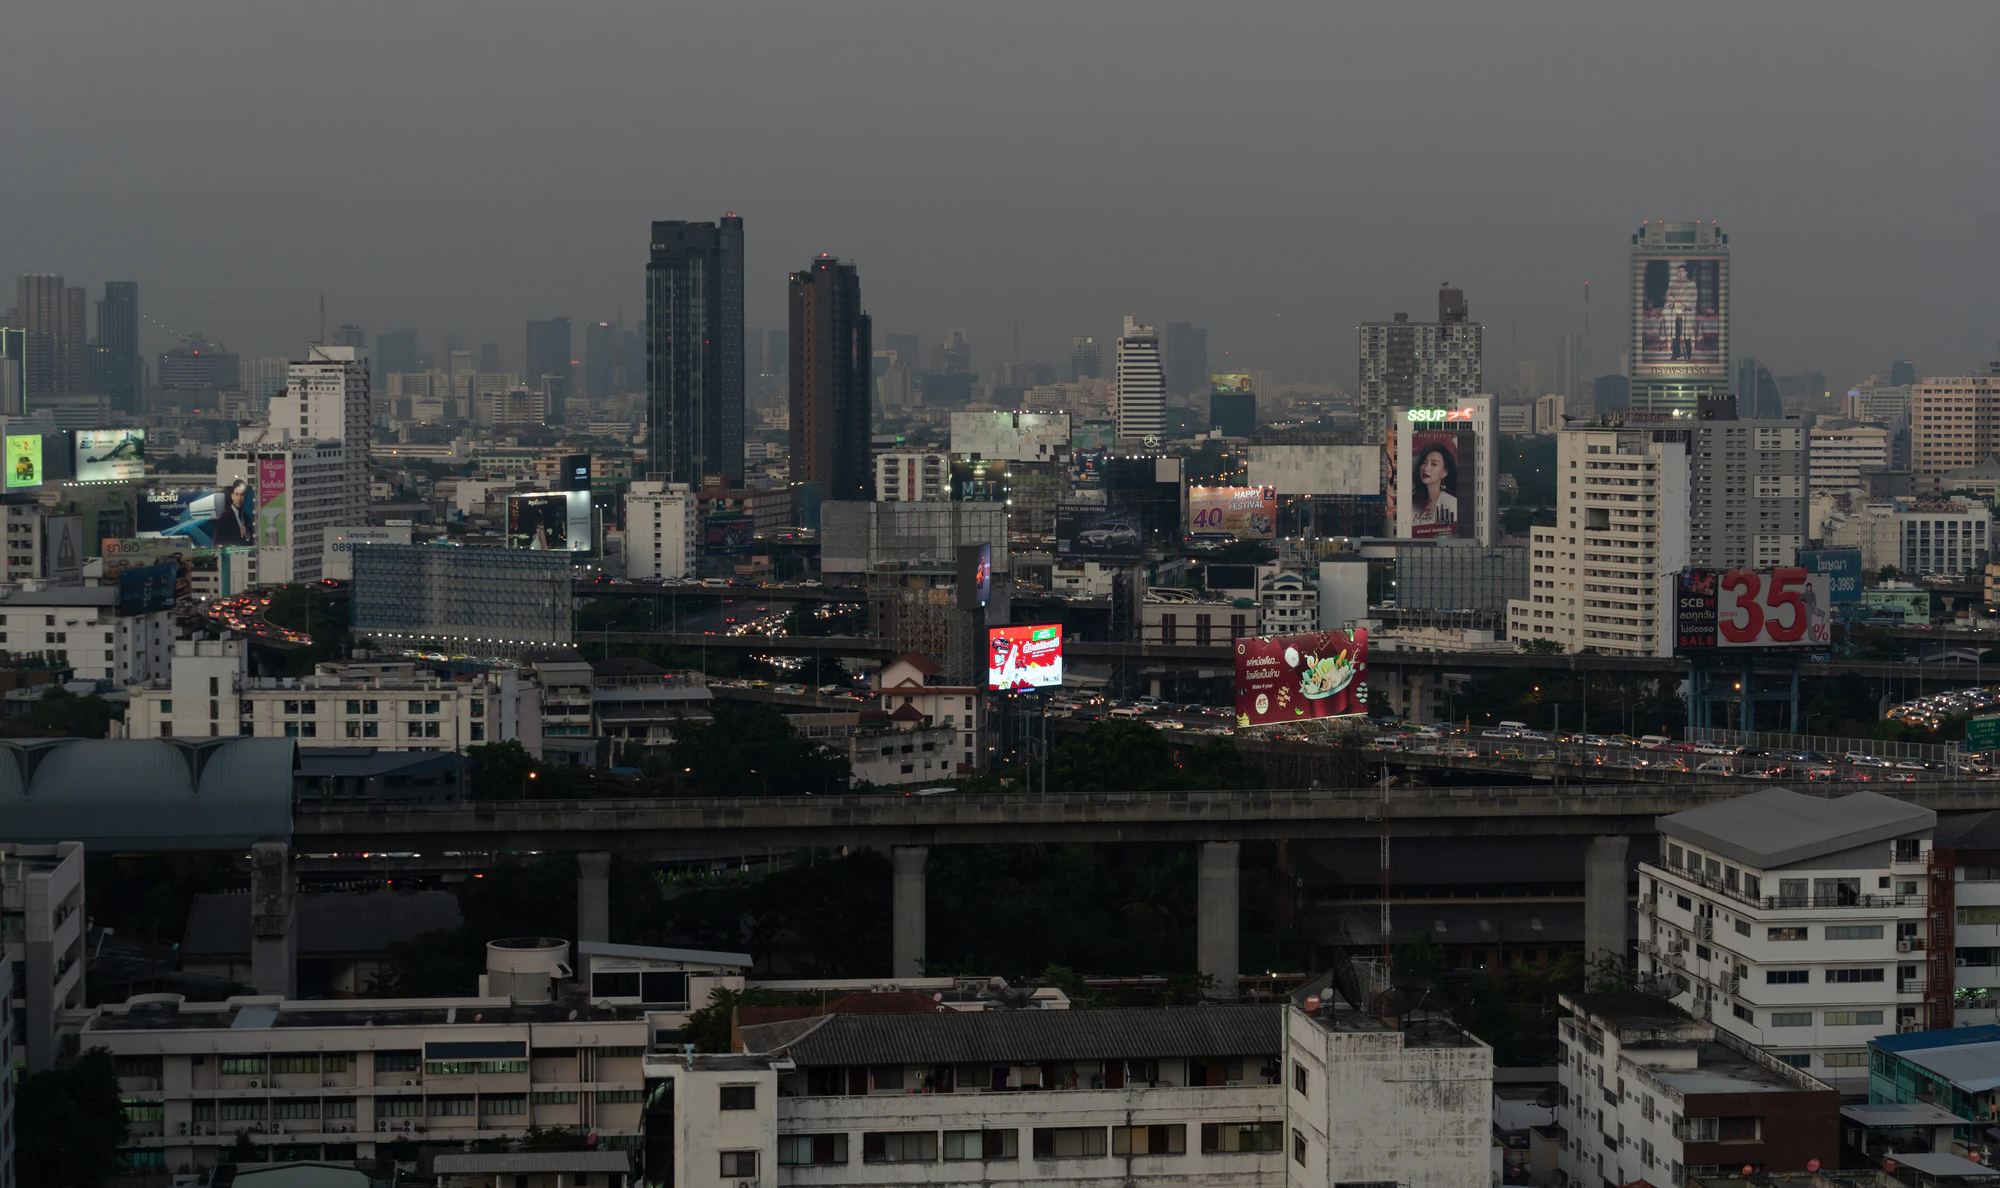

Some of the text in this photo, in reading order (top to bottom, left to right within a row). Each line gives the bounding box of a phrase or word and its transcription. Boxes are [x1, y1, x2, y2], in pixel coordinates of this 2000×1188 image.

[1651, 364, 1710, 374] ทรงพระเจริญ
[1407, 409, 1447, 422] SSUP
[1234, 489, 1261, 499] HAPPY
[1229, 500, 1264, 511] FESTIVAL
[107, 540, 140, 553] ยาโยอิ
[332, 543, 352, 552] 089
[1816, 554, 1847, 571] โฆษณา
[1679, 610, 1715, 621] ลดทุกวัน
[1719, 611, 1738, 619] สูงสุด
[1679, 624, 1715, 633] ไม่ต้องรอ
[1679, 635, 1715, 646] SALE
